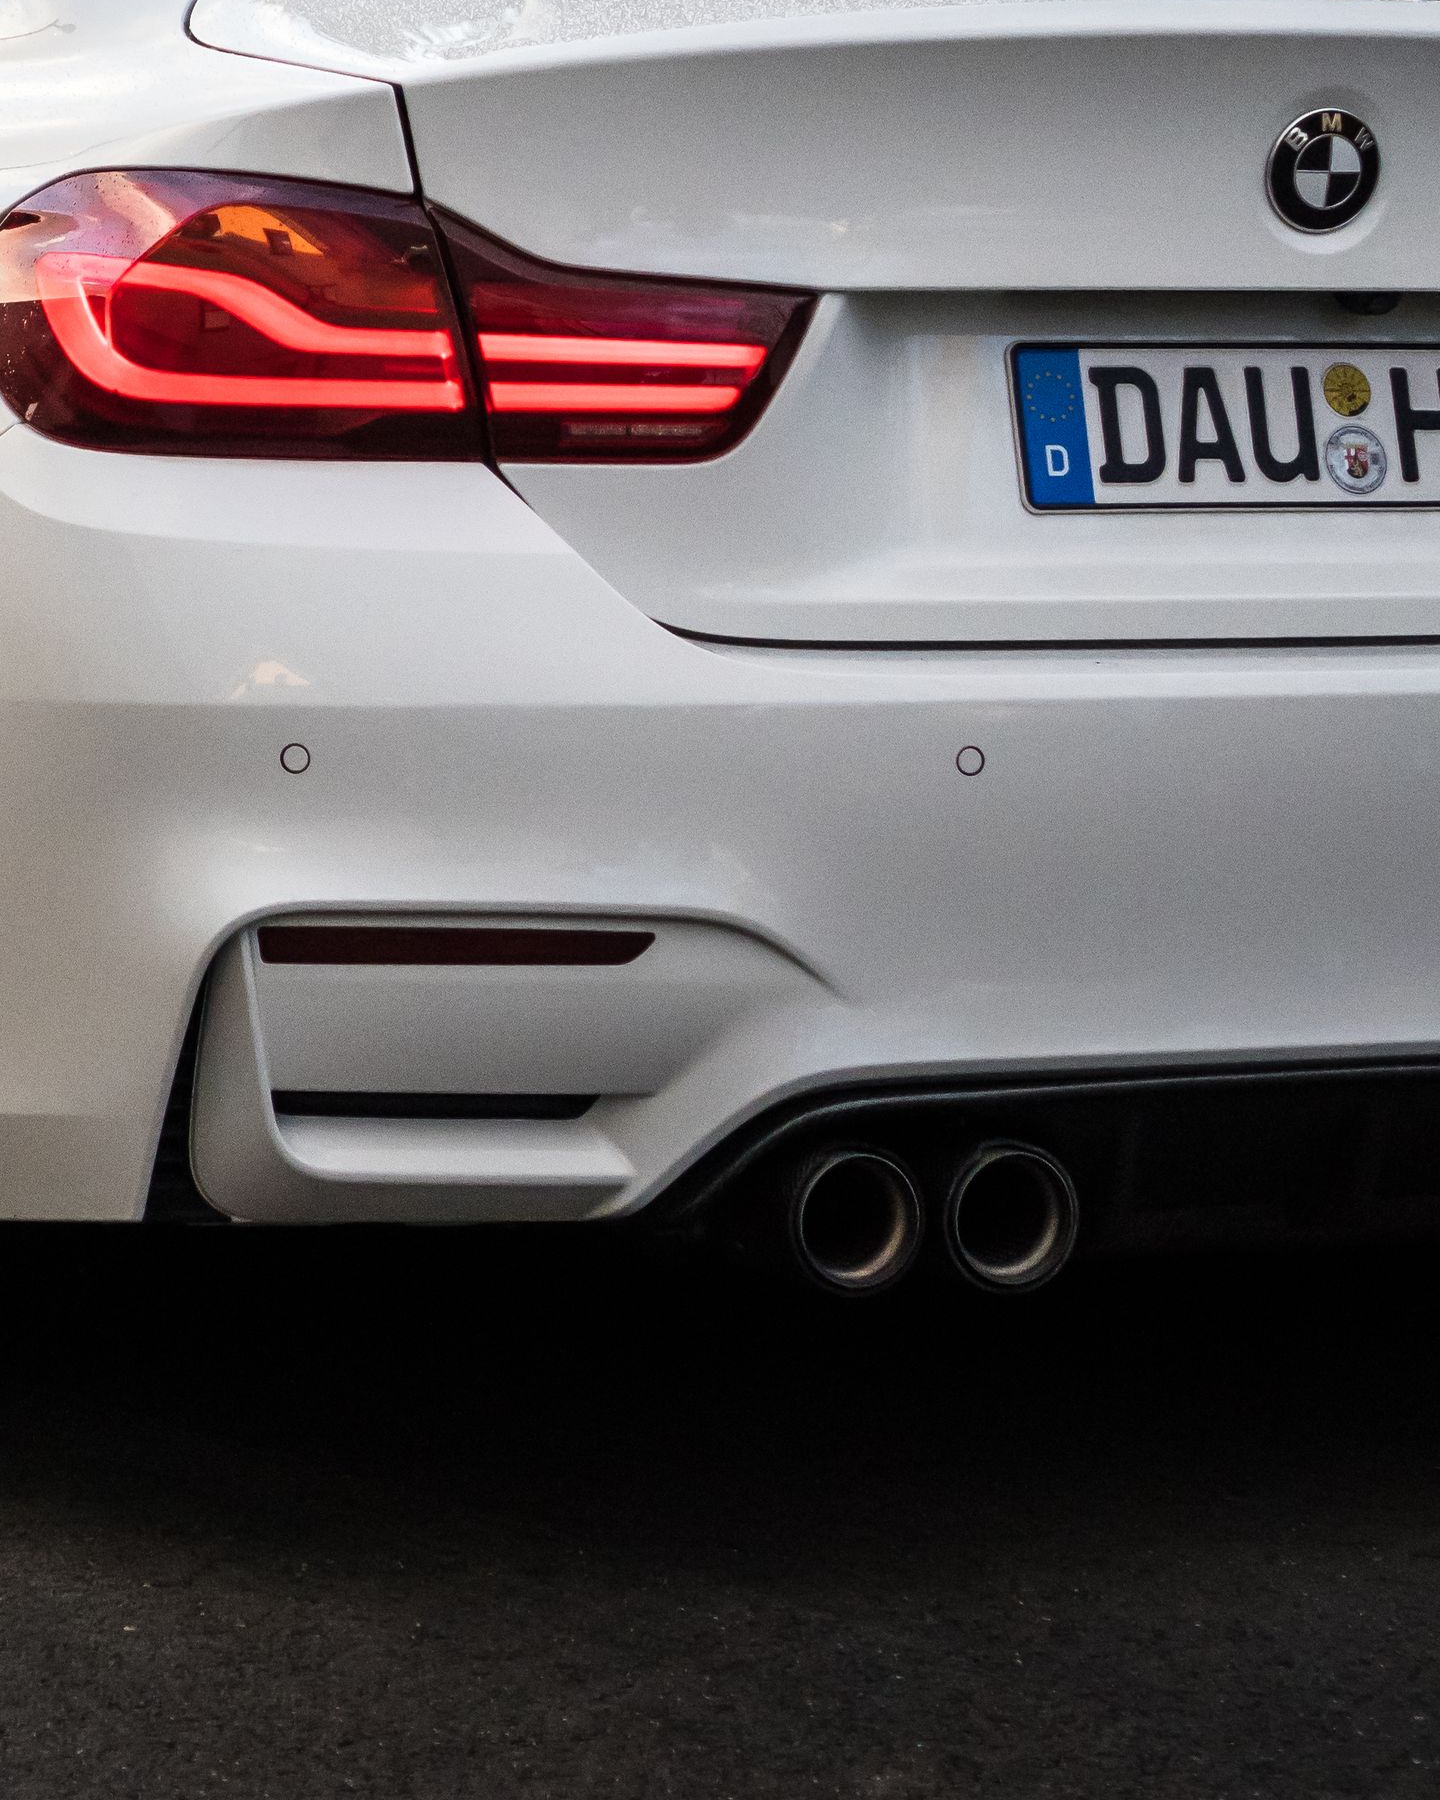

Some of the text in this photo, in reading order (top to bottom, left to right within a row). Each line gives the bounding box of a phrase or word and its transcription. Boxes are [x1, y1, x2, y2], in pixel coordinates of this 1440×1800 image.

[1285, 112, 1376, 152] BMW
[1088, 366, 1320, 483] DAU
[1045, 444, 1069, 476] D
